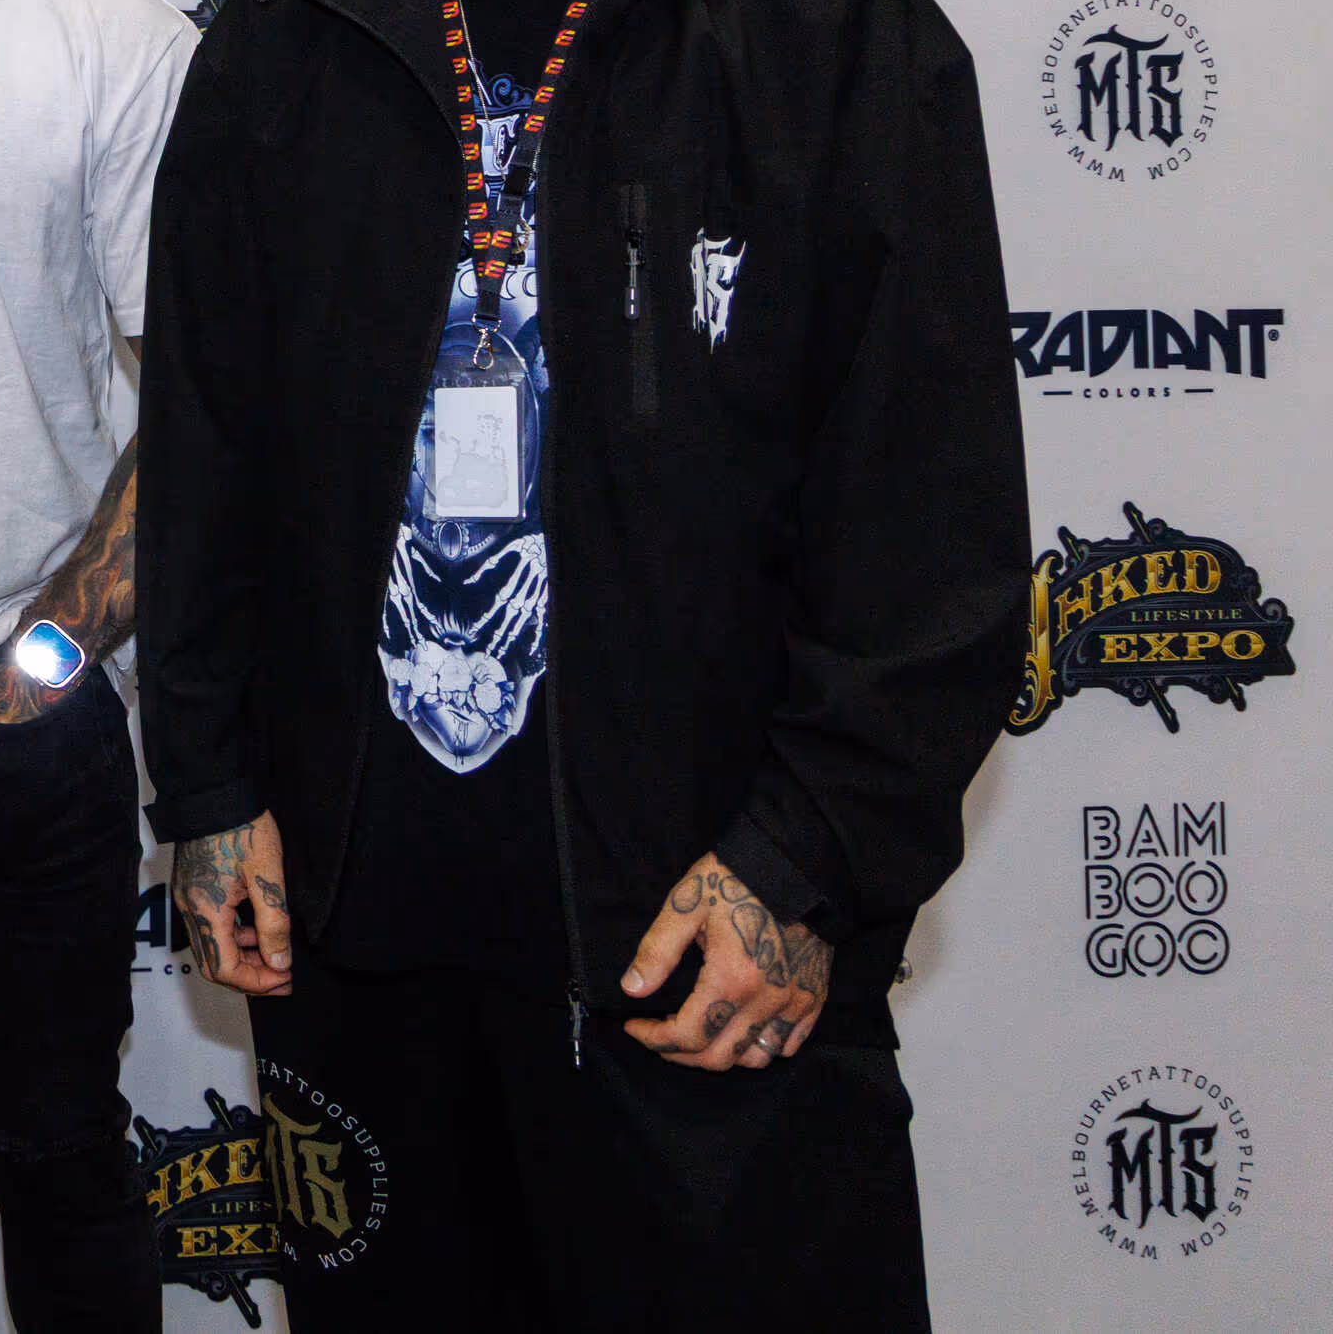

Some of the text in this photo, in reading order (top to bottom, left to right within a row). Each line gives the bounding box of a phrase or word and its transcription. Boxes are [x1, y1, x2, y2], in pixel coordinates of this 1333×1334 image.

[1074, 24, 1184, 152] MTS
[1084, 387, 1169, 398] COLORS
[1131, 608, 1242, 622] LIFESTYLE
[1099, 630, 1265, 663] EXPO
[1084, 802, 1226, 860] BAM
[1085, 860, 1227, 919] BOO
[1107, 1099, 1217, 1228] MTS
